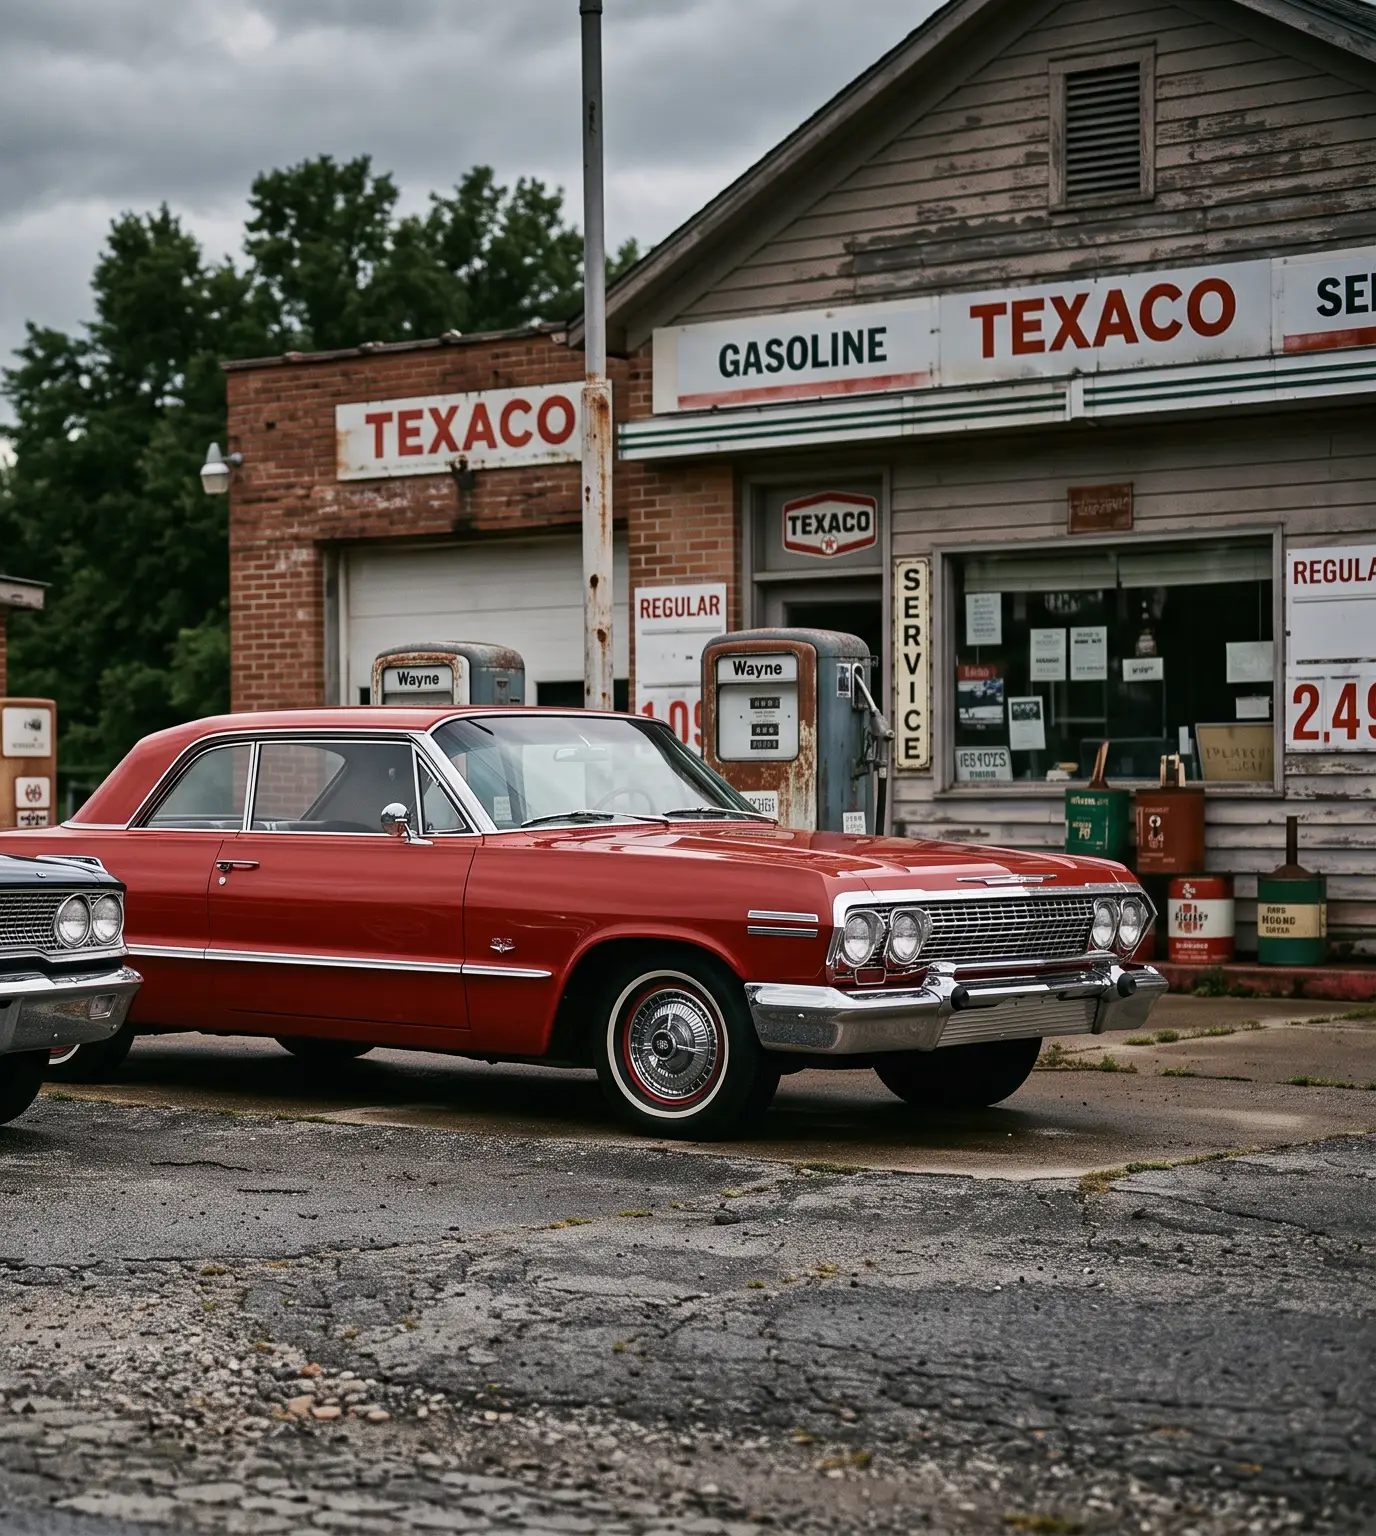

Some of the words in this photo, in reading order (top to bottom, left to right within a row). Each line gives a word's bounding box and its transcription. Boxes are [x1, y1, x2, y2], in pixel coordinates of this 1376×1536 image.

[1316, 273, 1376, 317] SE
[970, 278, 1236, 359] TEXACO
[719, 326, 887, 378] GASOLINE
[365, 394, 576, 459] TEXACO
[788, 510, 870, 536] TEXACO
[640, 595, 720, 619] REGULAR
[397, 671, 440, 688] Wayne
[733, 660, 783, 679] Wayne
[903, 568, 921, 760] SERVICE
